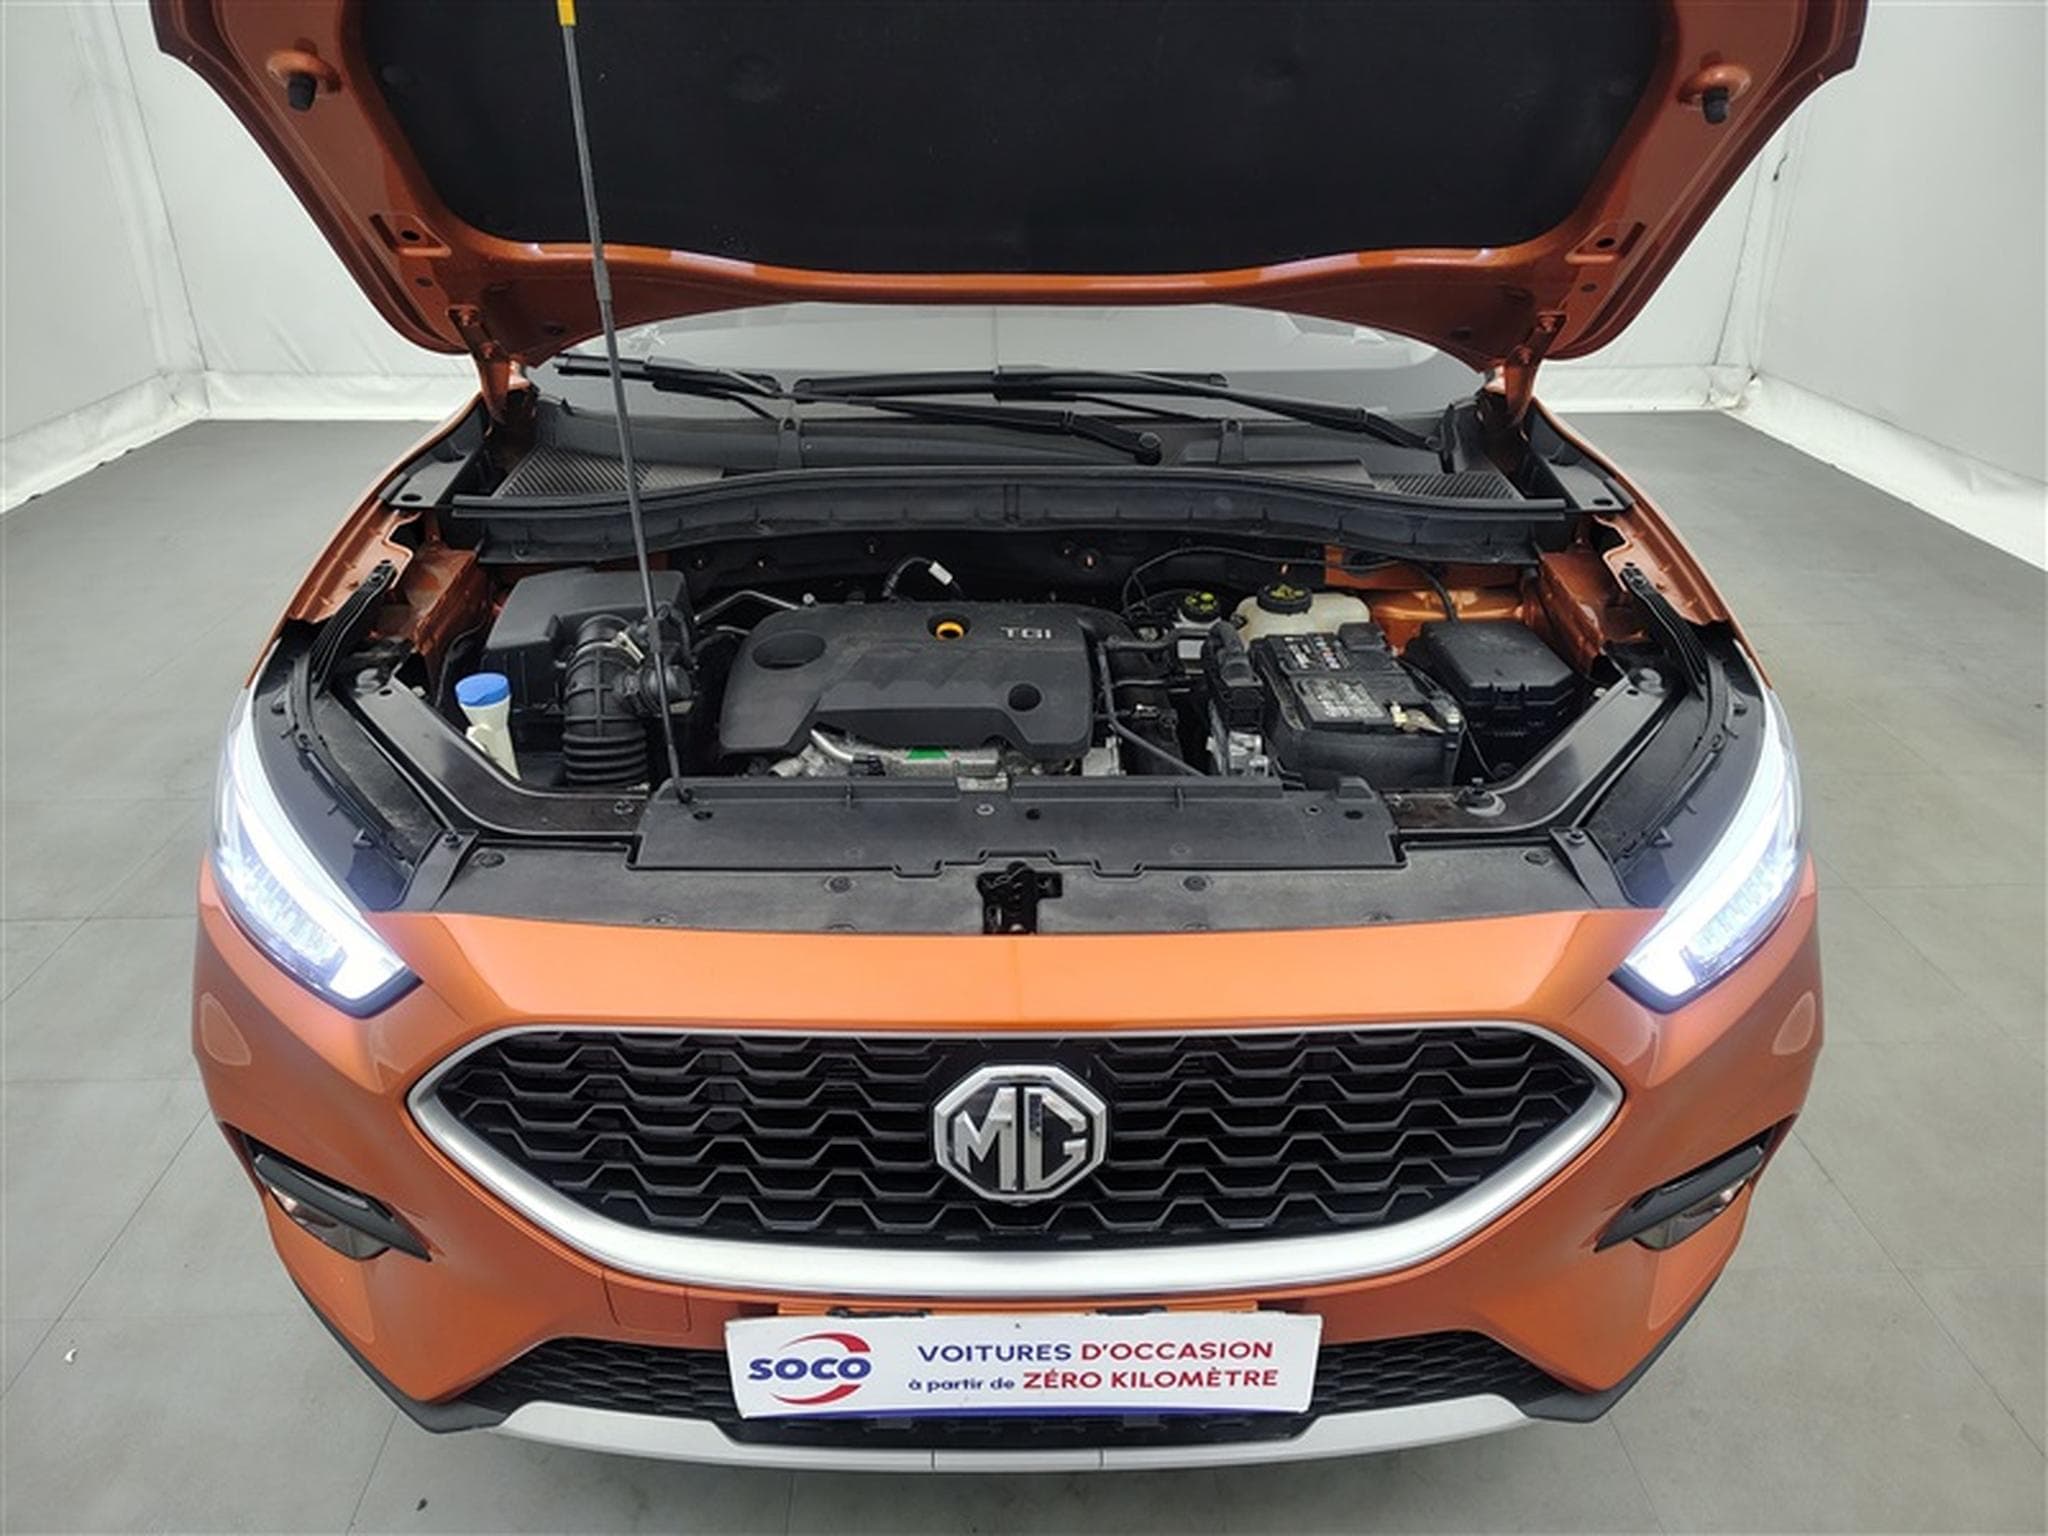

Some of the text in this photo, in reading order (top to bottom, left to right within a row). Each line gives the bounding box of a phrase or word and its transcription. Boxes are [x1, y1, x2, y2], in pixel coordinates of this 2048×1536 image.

[1000, 626, 1052, 639] TGI
[954, 1087, 1087, 1191] MG
[917, 1341, 1273, 1362] VOITURES D'OCCASION
[748, 1357, 872, 1380] SOCO
[908, 1366, 1278, 1393] à partir de ZÉRO KILOMÈTRE
